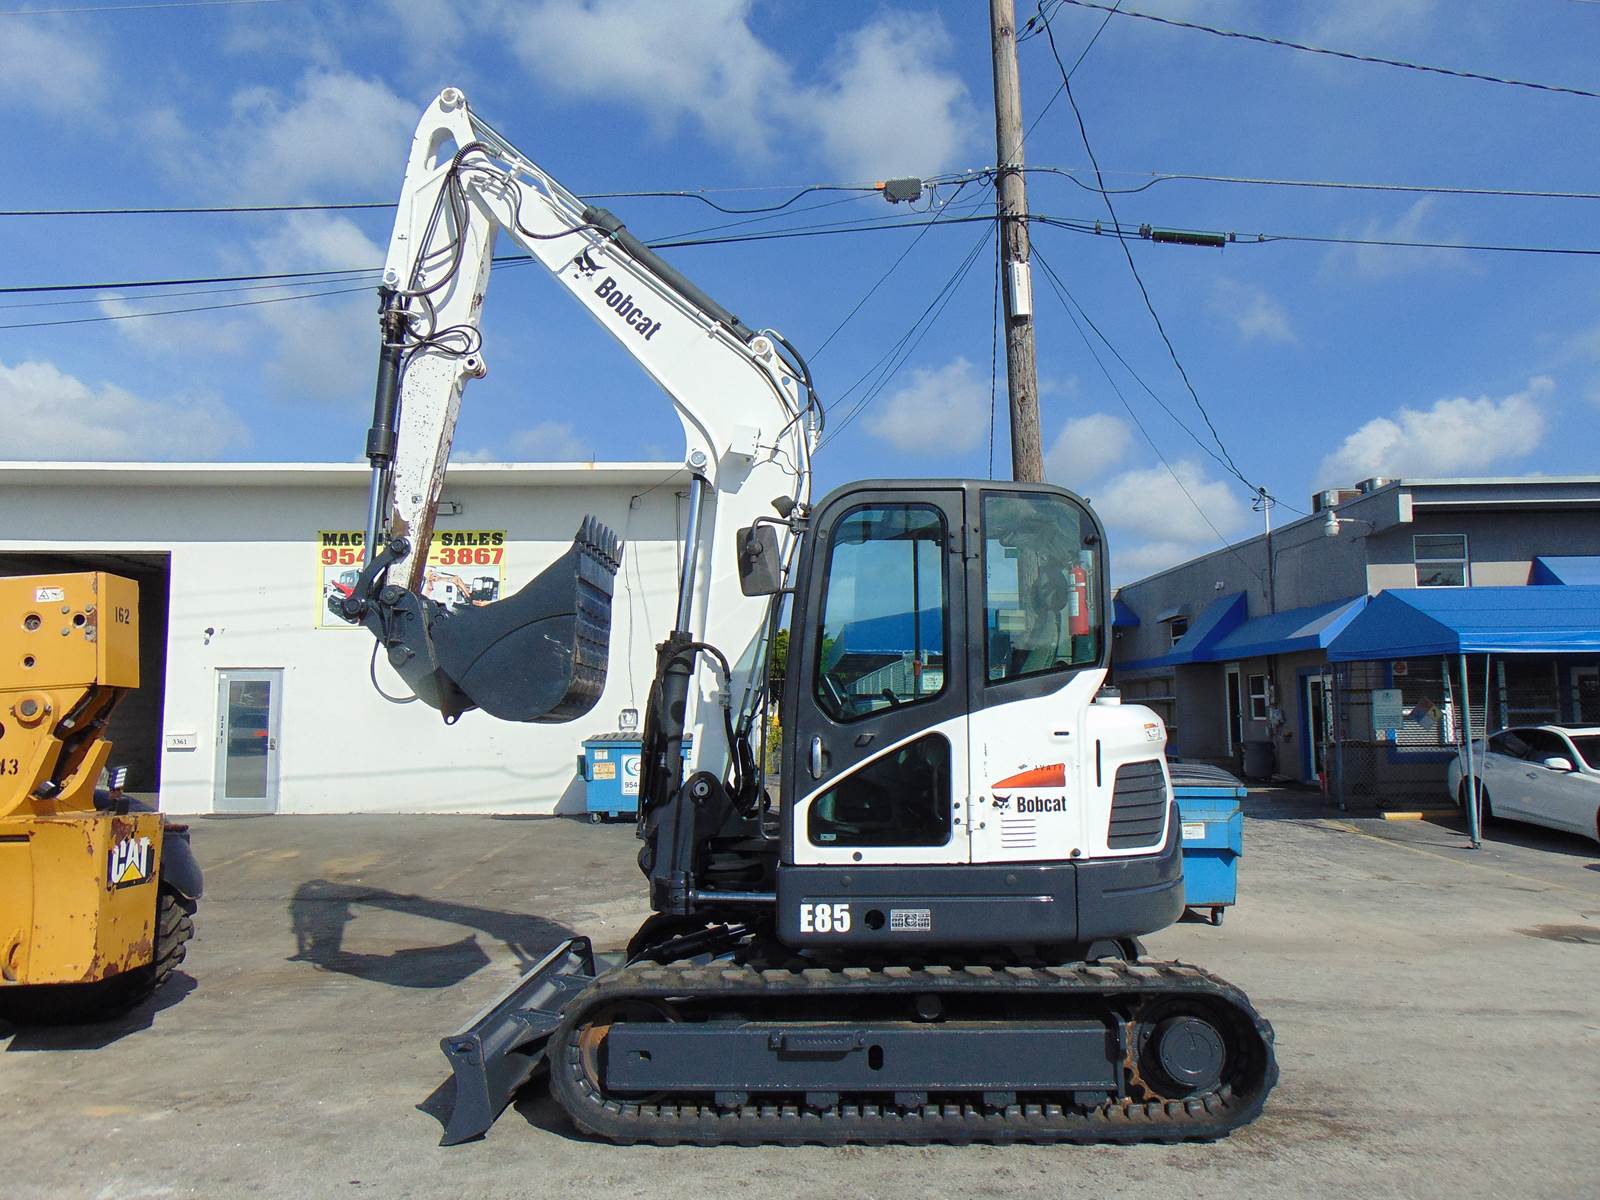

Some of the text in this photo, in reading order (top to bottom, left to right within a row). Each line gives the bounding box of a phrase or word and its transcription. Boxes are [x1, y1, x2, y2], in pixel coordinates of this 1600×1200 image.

[594, 276, 662, 341] Bobcat
[441, 532, 504, 546] SALES
[115, 606, 130, 625] 162
[1017, 796, 1067, 813] Bobcat
[111, 836, 151, 883] CAT
[800, 903, 851, 933] E85
